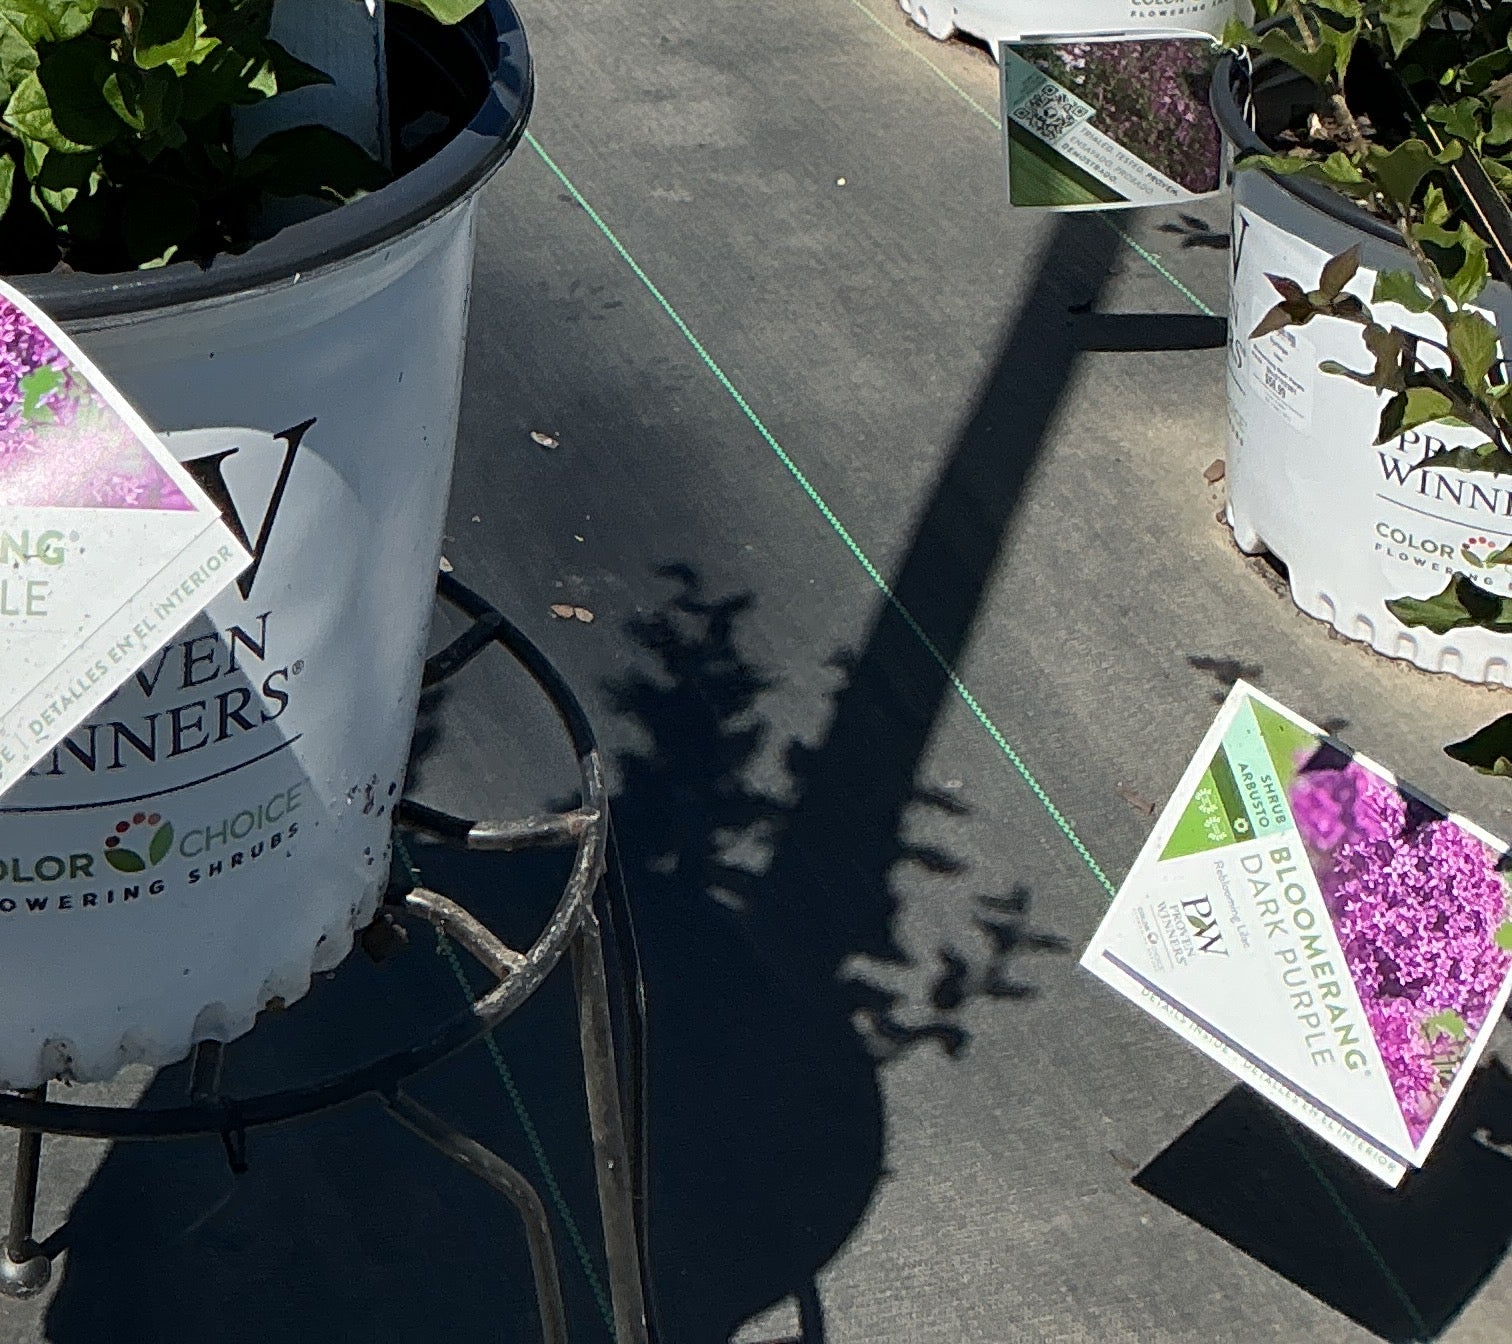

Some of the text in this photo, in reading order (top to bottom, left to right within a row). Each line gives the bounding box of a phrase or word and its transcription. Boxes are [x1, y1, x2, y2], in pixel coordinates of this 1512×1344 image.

[1376, 521, 1455, 561] COLOR
[28, 662, 109, 738] DETALLES
[108, 635, 135, 664] EN
[133, 617, 157, 640] EL
[154, 545, 234, 622] INTERIOR
[179, 782, 305, 859] CHOICE
[1238, 762, 1270, 828] ARBUSTO
[1260, 773, 1287, 825] SHRUB
[187, 820, 300, 885] SHRUBS
[1170, 904, 1194, 957] PROVEN
[1180, 893, 1230, 957] PW
[1240, 853, 1336, 1067] DARK PURPLE
